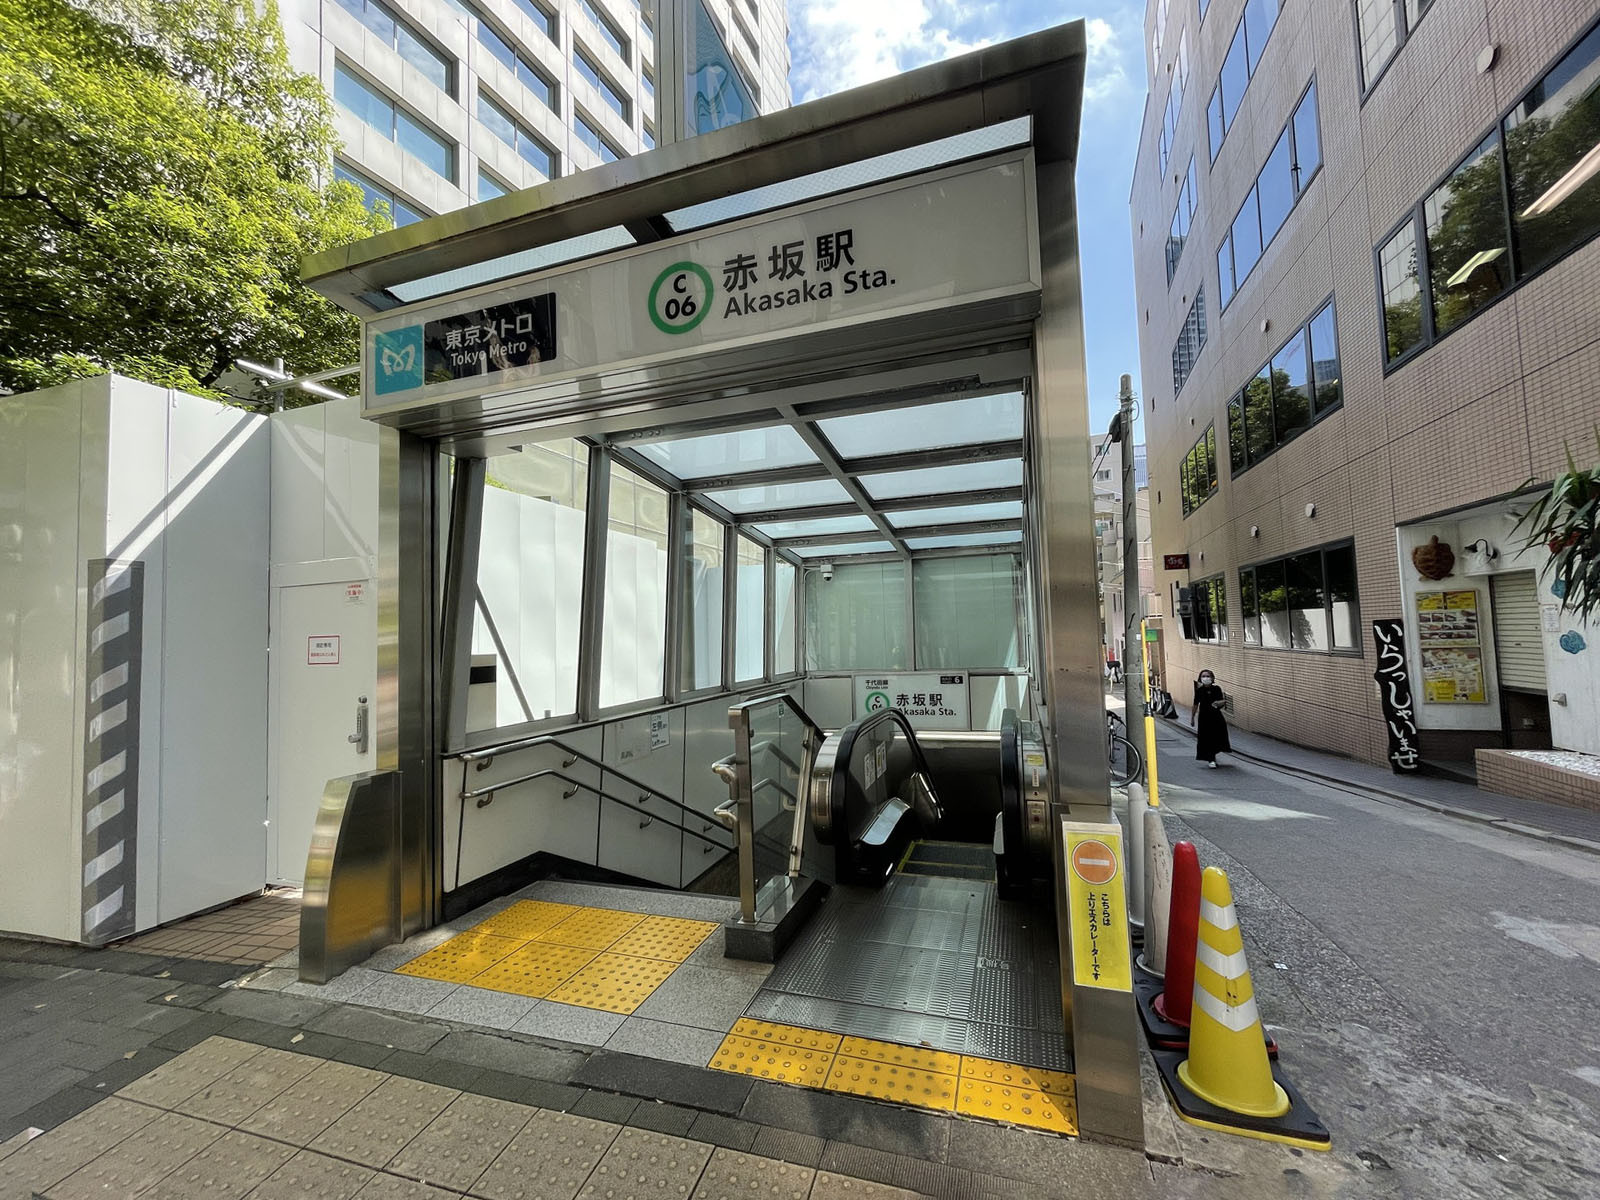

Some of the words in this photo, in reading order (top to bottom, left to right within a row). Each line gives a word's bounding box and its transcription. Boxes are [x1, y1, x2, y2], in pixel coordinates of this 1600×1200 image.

[722, 229, 855, 293] 赤坂駅
[673, 274, 687, 294] C
[723, 279, 833, 319] Akasaka
[843, 269, 896, 295] Sta.
[664, 295, 696, 320] 06
[445, 313, 532, 351] 東京メトロ
[450, 350, 487, 367] Tokyo
[489, 341, 527, 359] Metro
[954, 676, 960, 684] 6
[896, 694, 943, 706] 赤坂駅
[1374, 624, 1418, 769] いらっしゃいませ
[939, 708, 957, 716] Sta.
[1101, 893, 1111, 927] こちらは
[1087, 892, 1100, 981] 上りエスカレーターです
